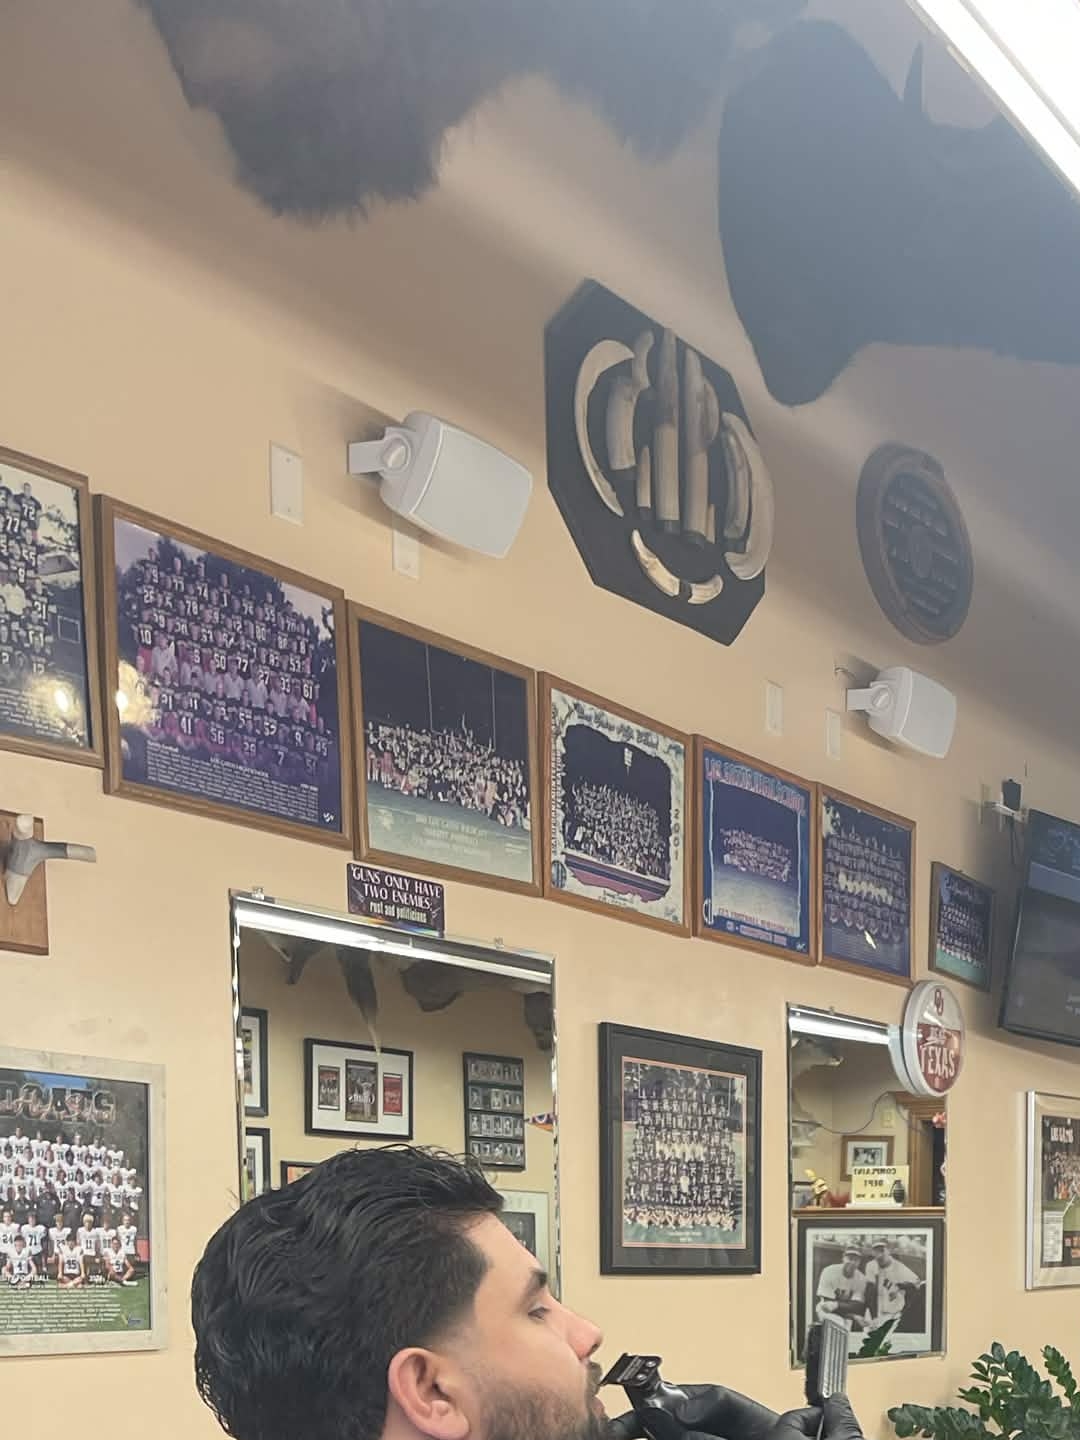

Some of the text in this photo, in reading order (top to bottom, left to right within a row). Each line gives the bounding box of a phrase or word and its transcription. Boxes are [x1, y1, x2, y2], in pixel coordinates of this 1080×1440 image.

[6, 515, 20, 533] 77
[140, 630, 152, 645] 10
[303, 684, 313, 699] 61
[181, 716, 191, 735] 41
[673, 809, 681, 861] 2001
[363, 883, 388, 900] TWO
[385, 875, 410, 891] ONLY
[415, 881, 443, 898] HAVE
[385, 904, 395, 917] and
[920, 1046, 955, 1080] TEXAS
[28, 1234, 38, 1246] 71
